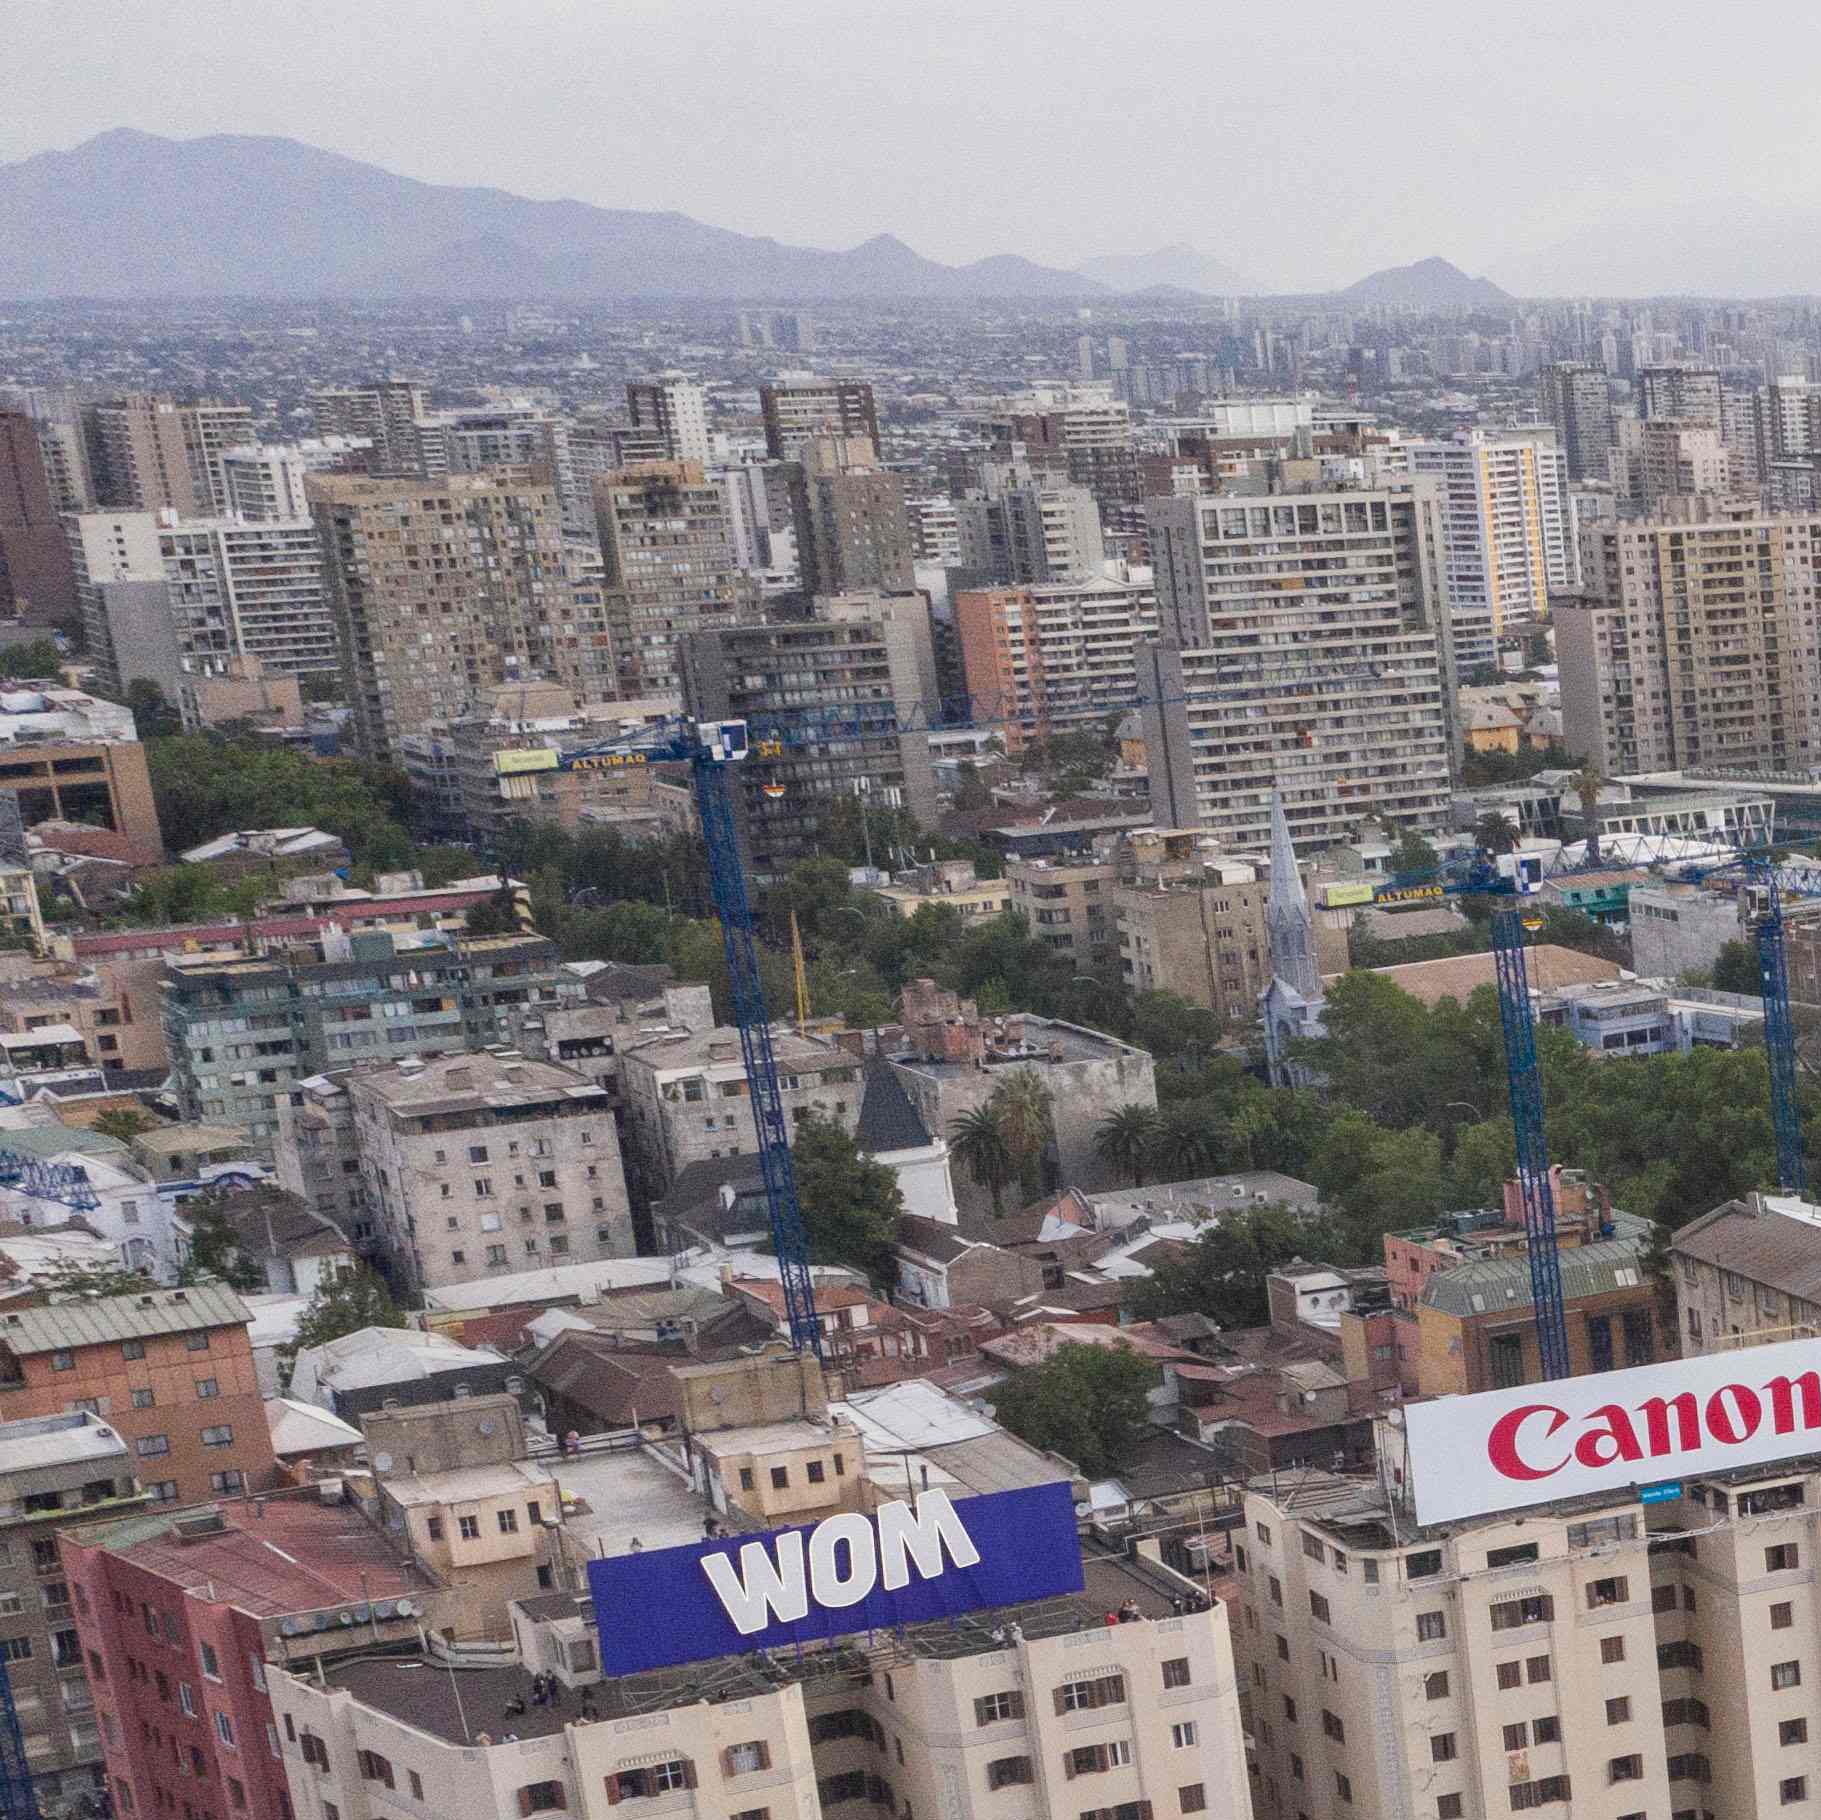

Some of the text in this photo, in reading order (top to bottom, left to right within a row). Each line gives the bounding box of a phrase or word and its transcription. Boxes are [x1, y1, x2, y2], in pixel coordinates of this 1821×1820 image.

[572, 754, 645, 769] ALTUMAQ
[1378, 886, 1443, 903] ALTUMAQ
[701, 1488, 981, 1635] WOM
